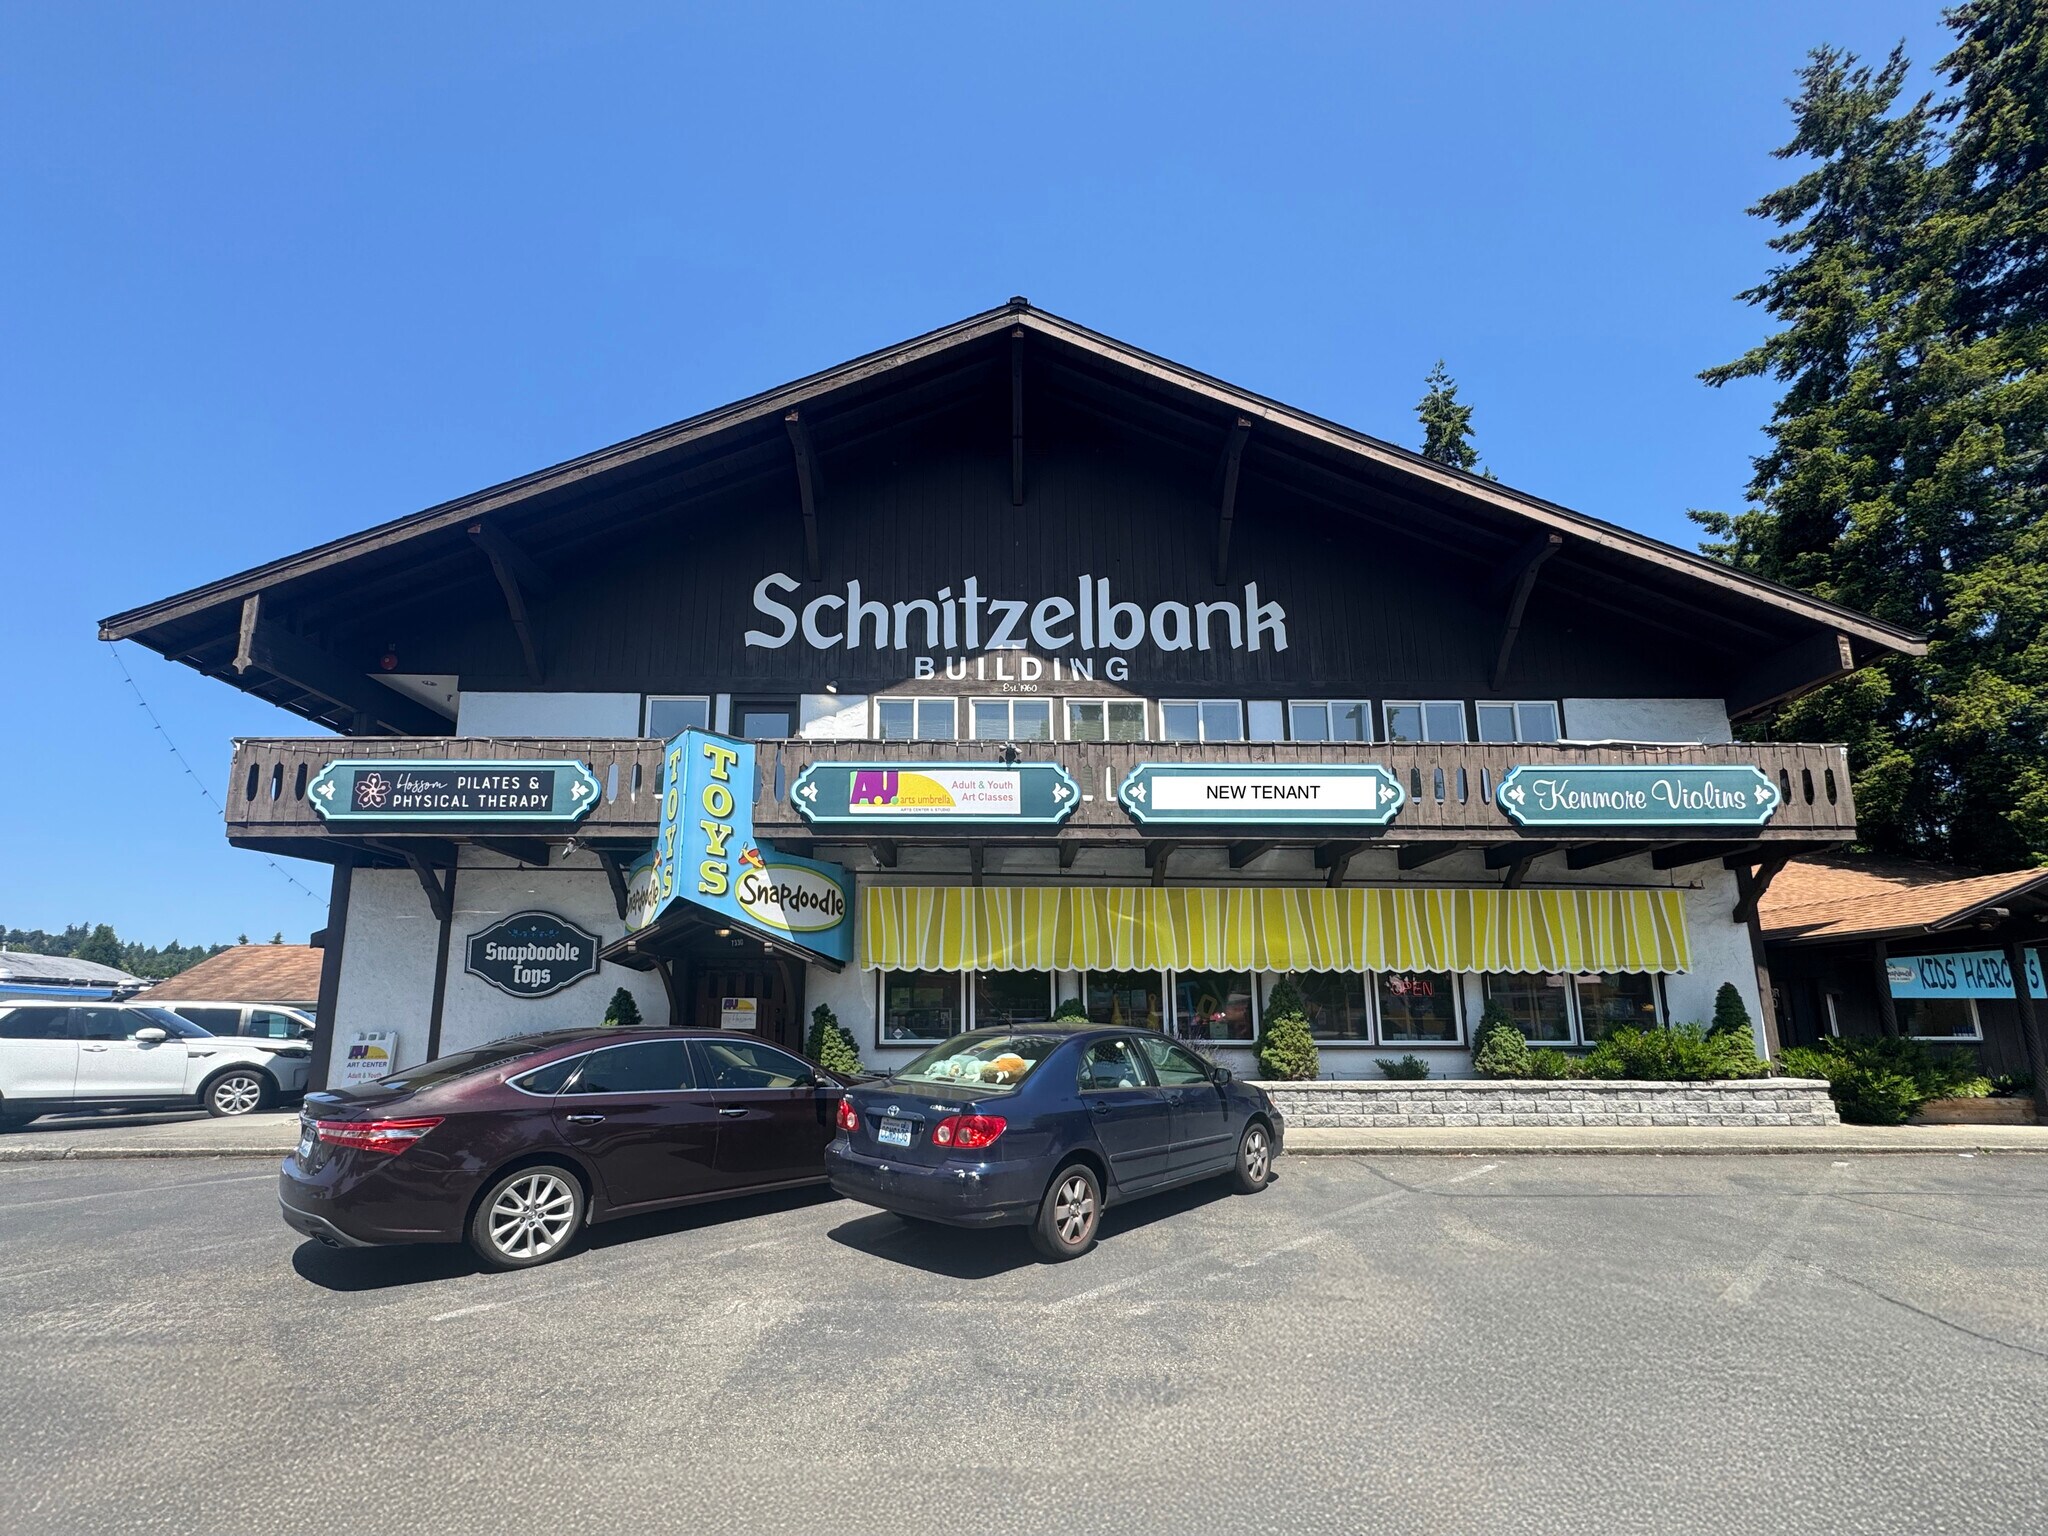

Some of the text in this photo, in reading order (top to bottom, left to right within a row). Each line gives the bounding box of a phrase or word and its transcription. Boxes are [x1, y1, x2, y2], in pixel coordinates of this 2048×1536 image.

[744, 572, 1289, 652] Schnitzelbank
[914, 656, 1129, 681] BUILDING
[457, 776, 521, 790] PILATES
[529, 776, 540, 790] &
[951, 780, 1014, 790] Adult & Youth
[1206, 785, 1321, 799] NEW TENANT
[1532, 779, 1746, 810] Kenmore Violins
[393, 794, 549, 808] PHYSICAL THERAPY
[900, 793, 950, 805] arts umbrella
[961, 792, 1014, 802] Art Classes
[661, 745, 682, 900] TOYS
[698, 742, 738, 896] TOYS
[739, 874, 844, 916] Snapdoodle
[485, 941, 580, 965] Snapdoodle
[513, 964, 551, 988] Toys
[1917, 957, 2040, 990] KIDS' HAIRCS
[1391, 981, 1433, 997] OPEN
